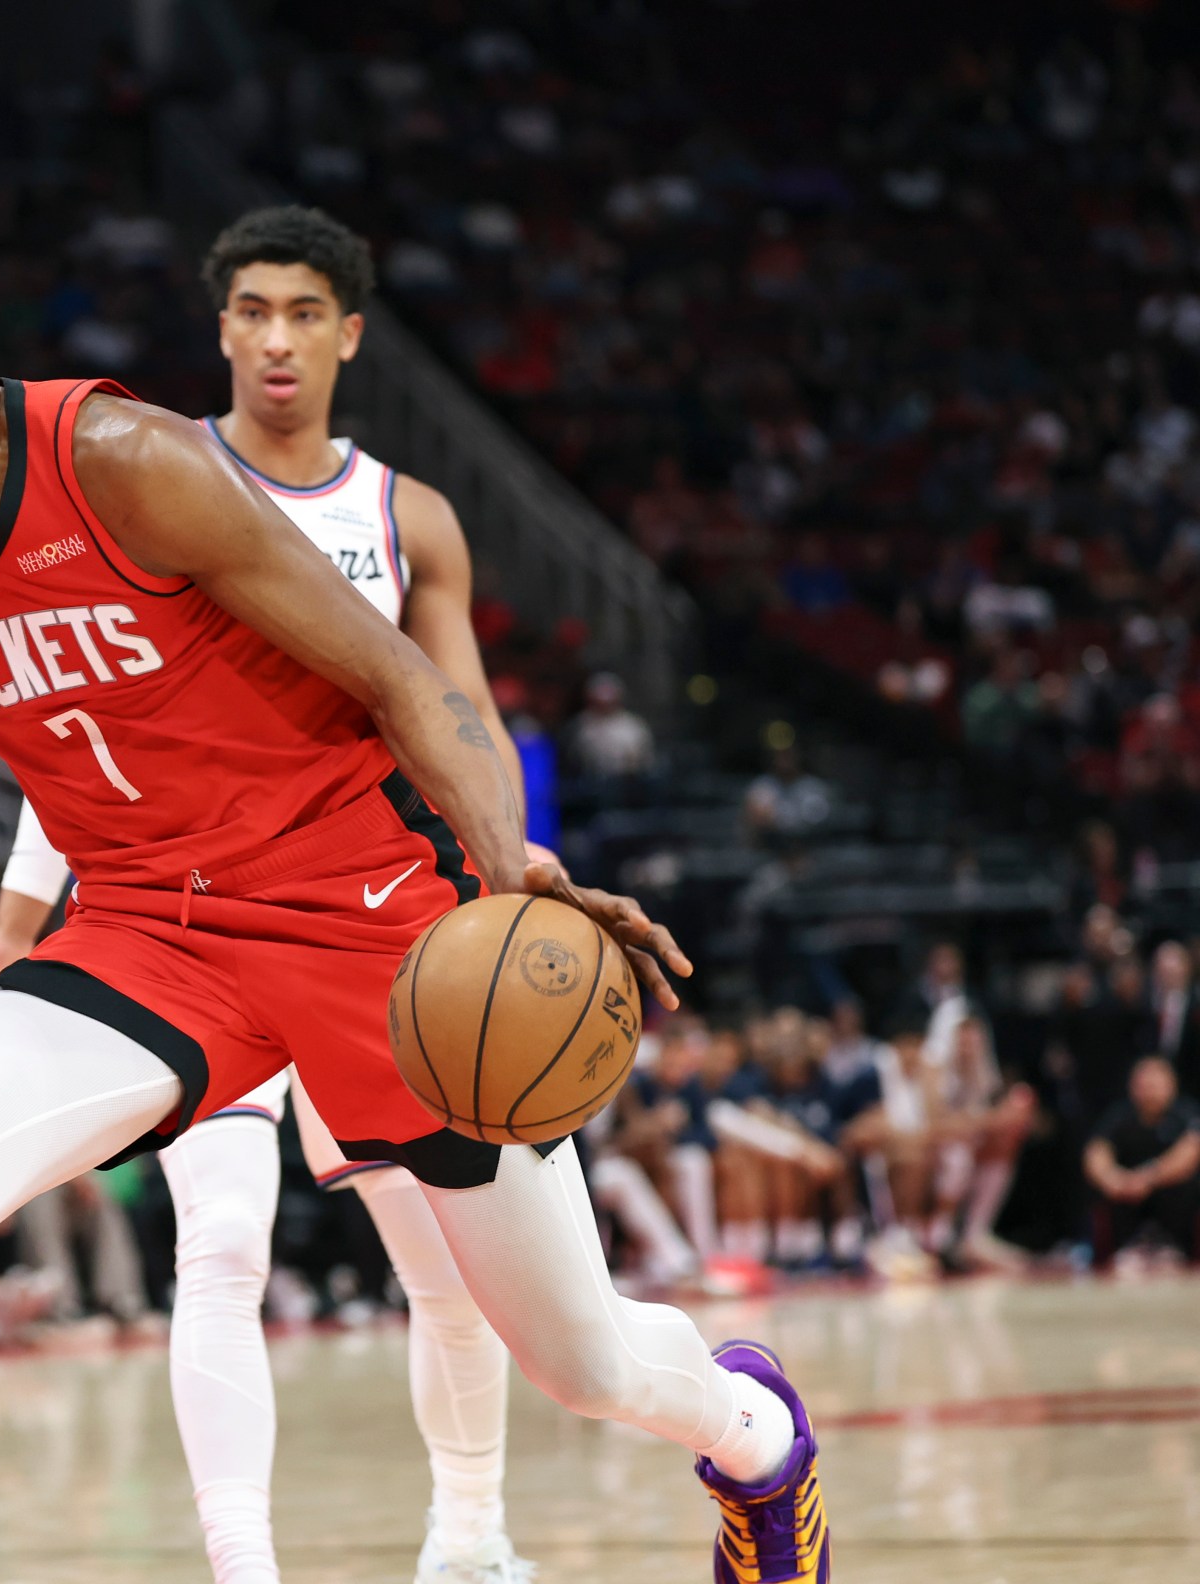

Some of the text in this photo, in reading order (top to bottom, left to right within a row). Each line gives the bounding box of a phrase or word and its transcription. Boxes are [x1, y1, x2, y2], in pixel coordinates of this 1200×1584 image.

[16, 533, 84, 566] MEMORIAL
[19, 539, 87, 575] HERMANN
[42, 708, 142, 802] 7
